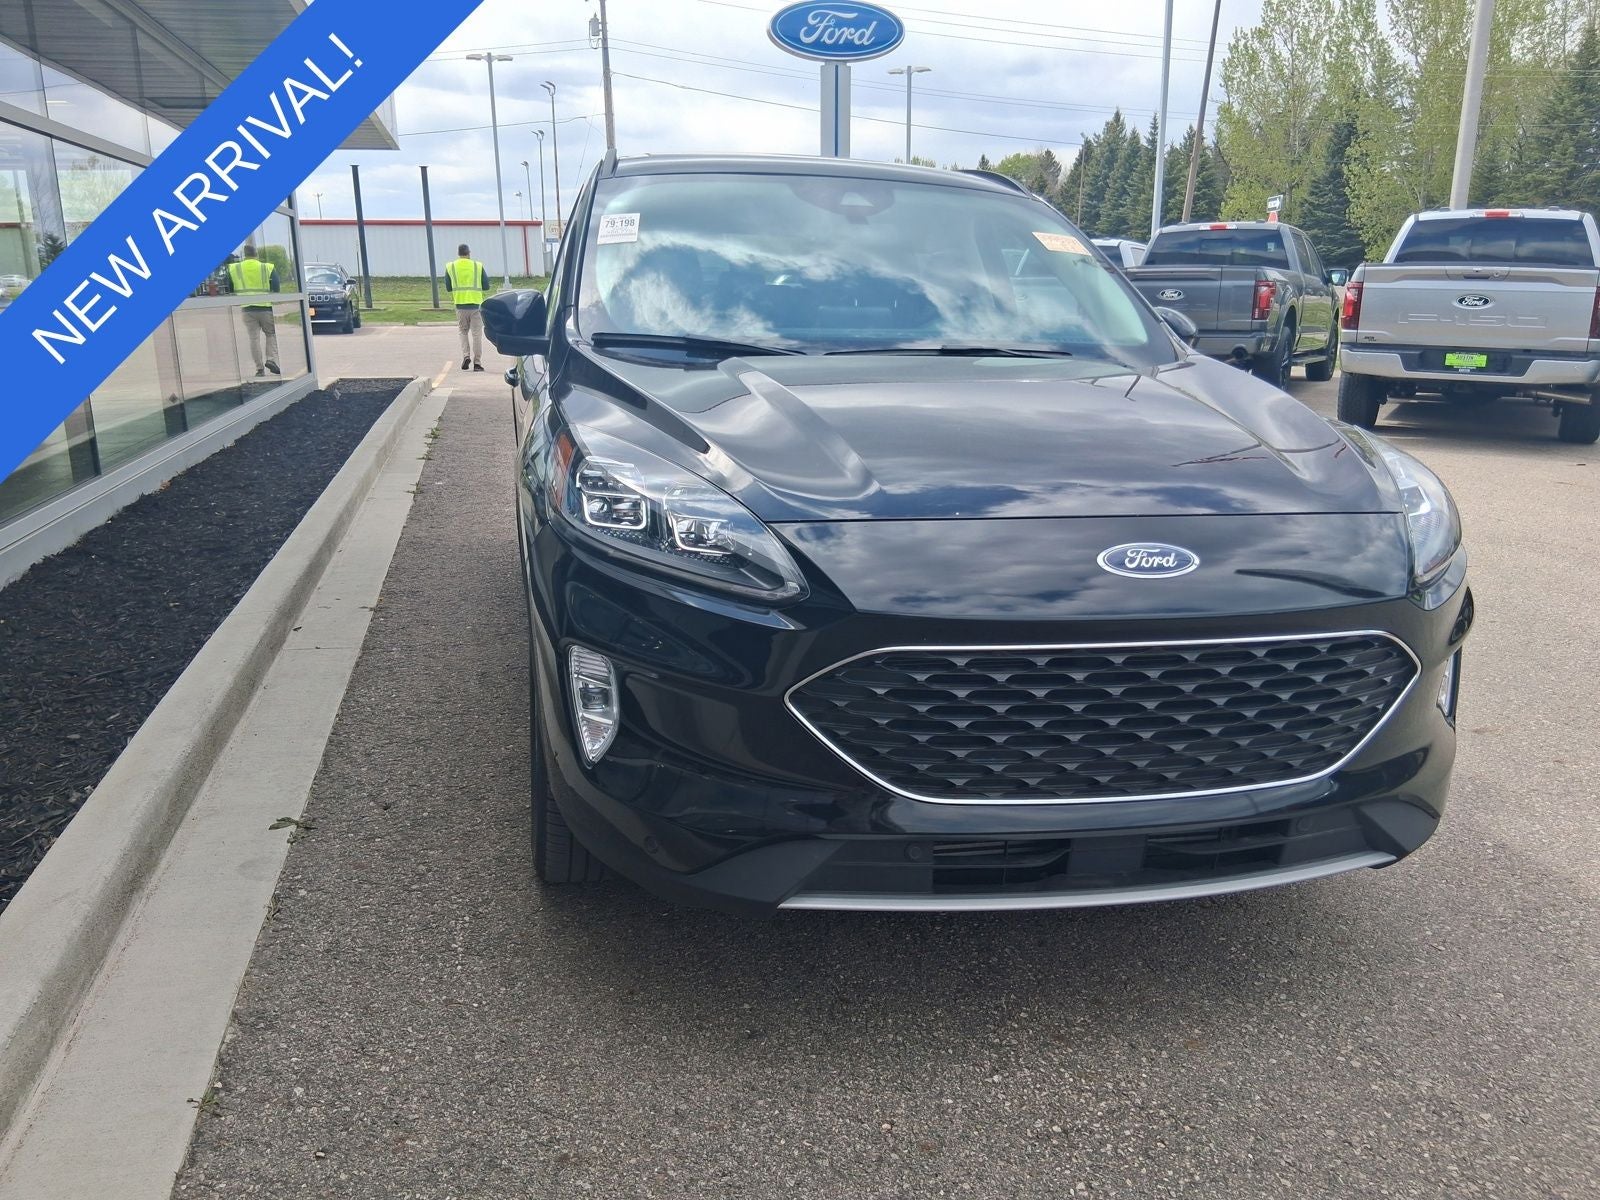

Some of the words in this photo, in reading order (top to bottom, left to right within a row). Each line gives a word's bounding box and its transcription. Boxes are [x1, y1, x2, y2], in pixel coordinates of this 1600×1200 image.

[799, 9, 878, 46] Ford
[1461, 295, 1485, 307] Ford
[1398, 312, 1547, 328] F-150
[1124, 547, 1178, 568] Ford
